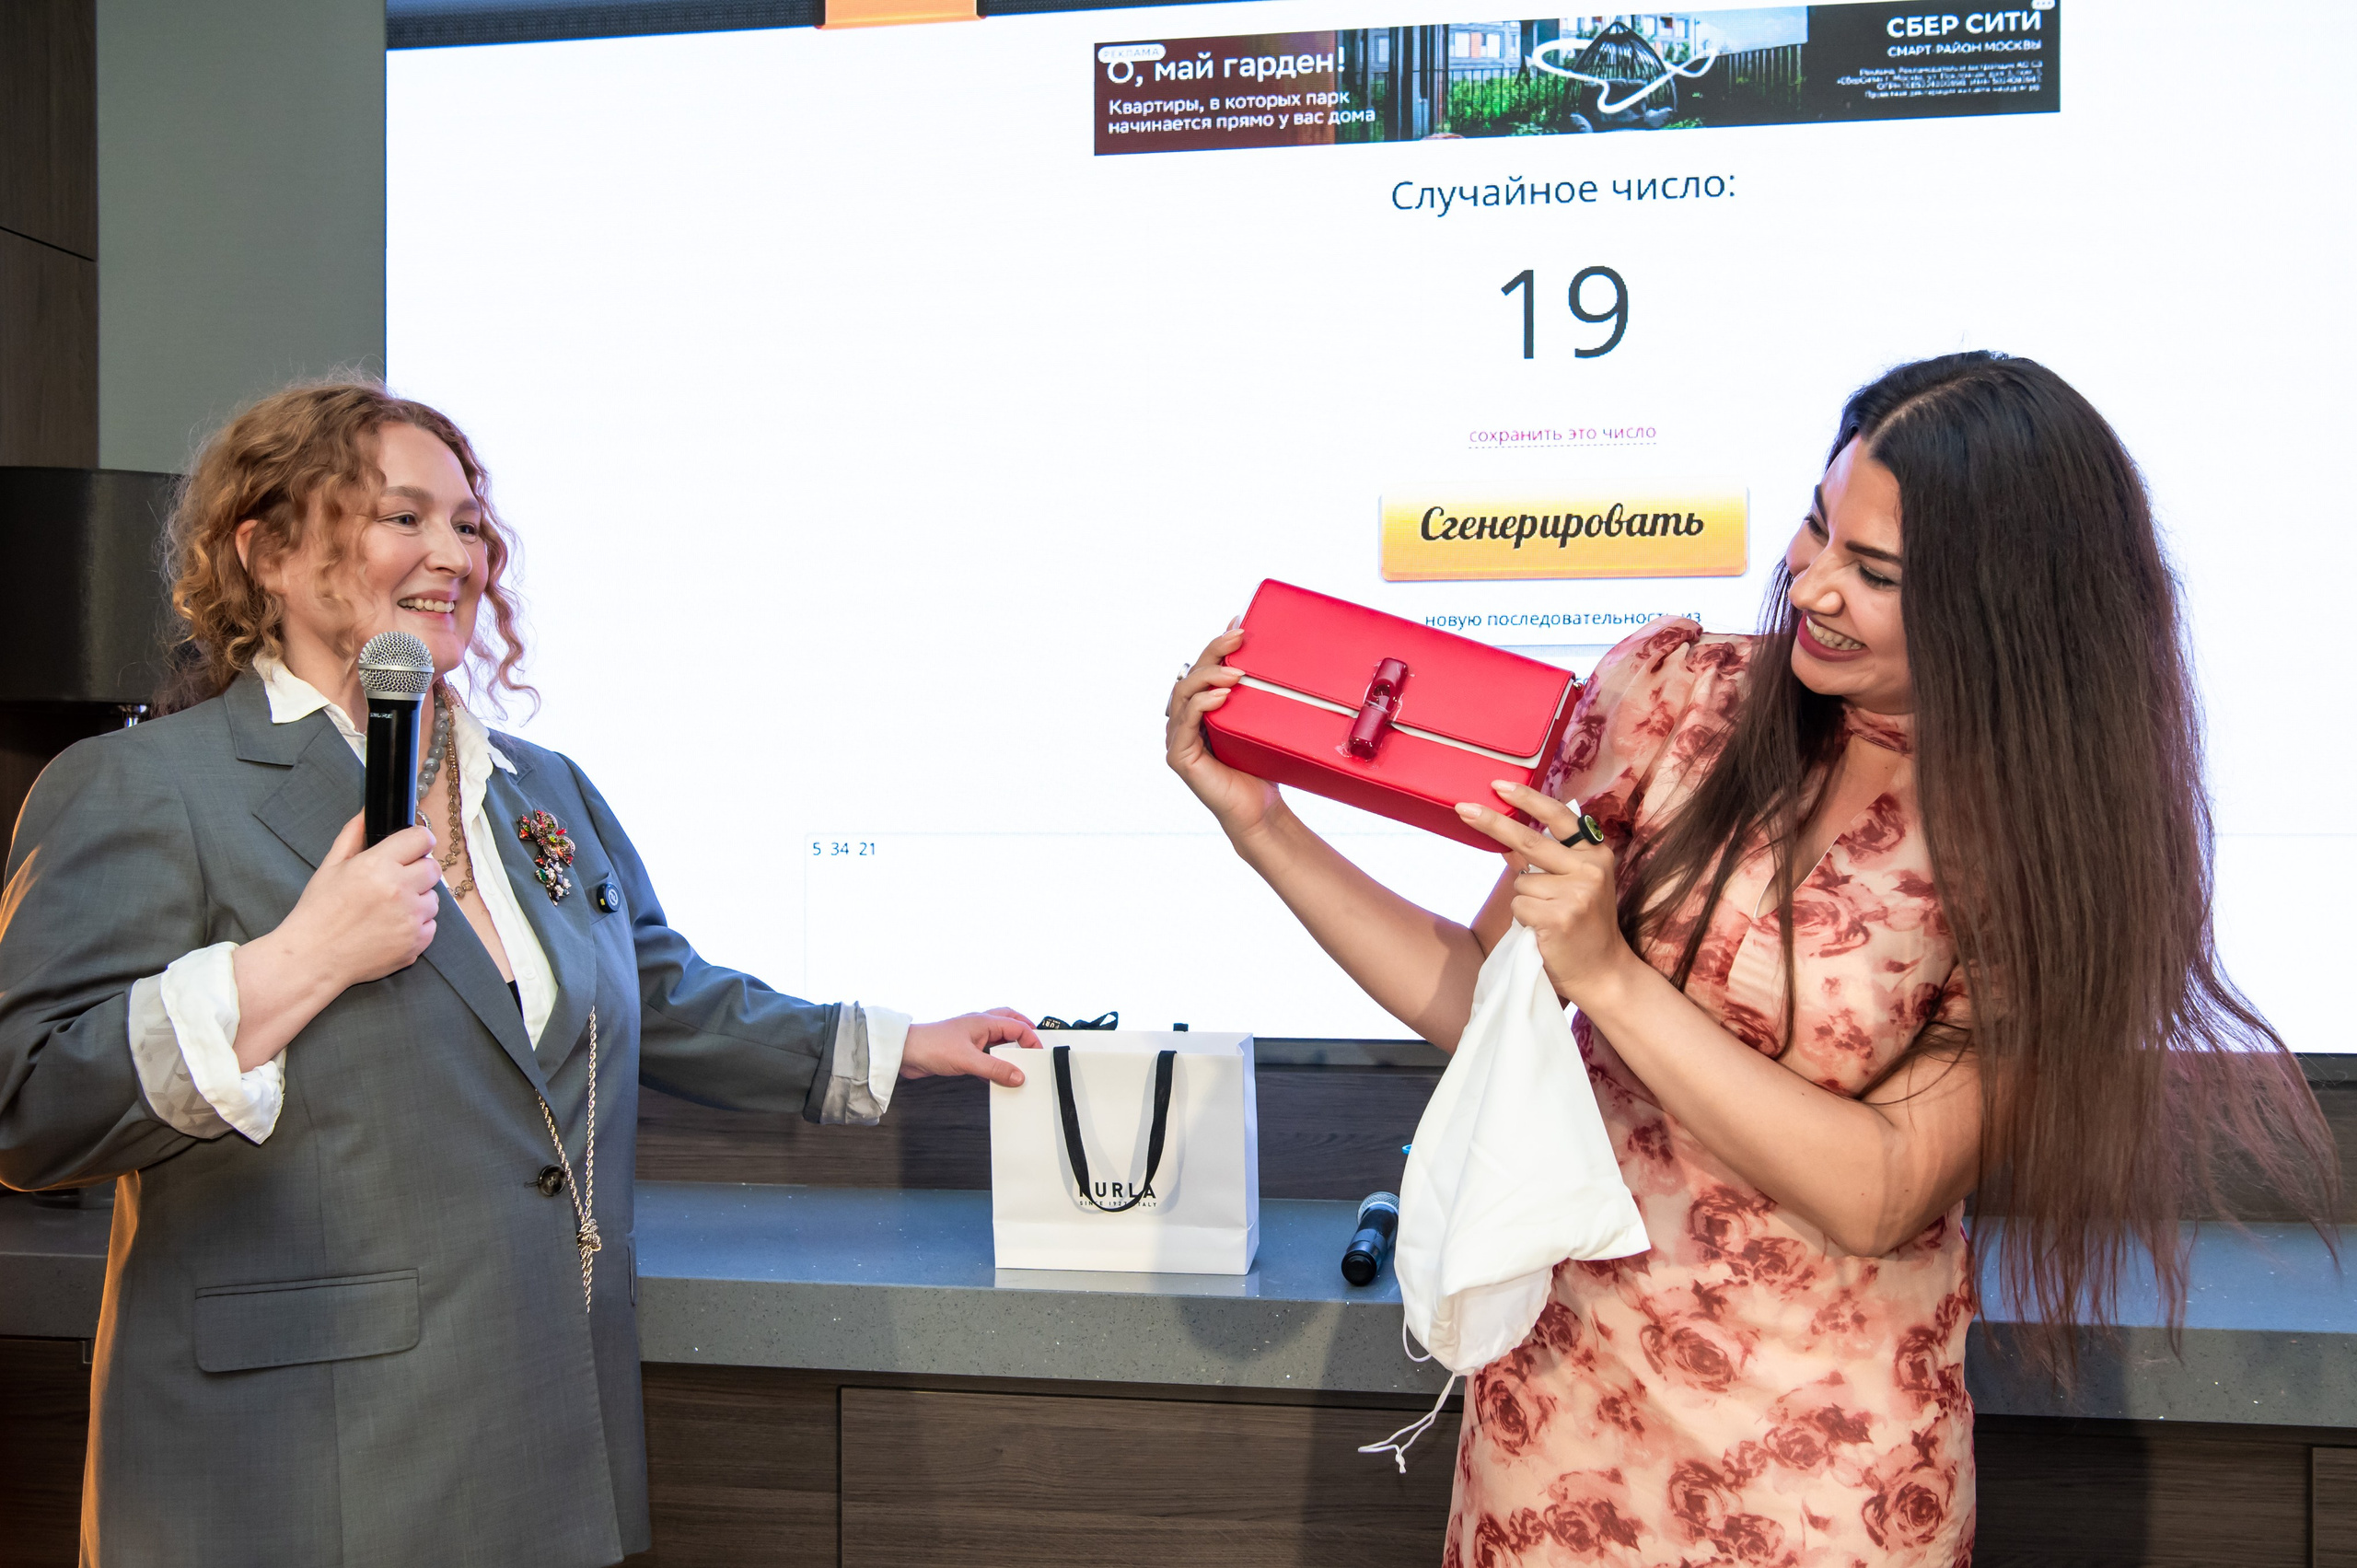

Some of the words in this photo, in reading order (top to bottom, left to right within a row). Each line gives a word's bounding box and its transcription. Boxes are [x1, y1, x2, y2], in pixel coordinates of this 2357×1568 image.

[1887, 14, 1960, 39] СБЕР
[1965, 10, 2042, 34] СИТИ
[1104, 48, 1160, 59] РЕКЛАМА
[1887, 43, 1933, 57] СМАРТ
[1936, 41, 1982, 54] РАЙОН
[1984, 39, 2042, 52] МОСКВЫ
[1107, 59, 1144, 87] О,
[1154, 51, 1214, 82] май
[1223, 46, 1346, 83] гарден!
[1109, 99, 1205, 117] Квартиры,
[1209, 97, 1220, 110] в
[1225, 94, 1302, 111] которых
[1306, 90, 1351, 108] парк
[1108, 117, 1213, 134] начинается
[1216, 113, 1275, 132] прямо
[1278, 112, 1290, 130] у
[1293, 110, 1324, 125] вас
[1327, 109, 1376, 125] дома
[1391, 175, 1598, 218] Случайное
[1612, 174, 1736, 201] число:
[1500, 264, 1630, 359] 19
[1469, 428, 1562, 446] сохранить
[1568, 428, 1597, 440] это
[1603, 426, 1656, 440] число
[1421, 502, 1705, 550] Сгенерировать
[1425, 613, 1482, 632] новую
[1488, 611, 1668, 629] последовательнос
[812, 842, 821, 856] 5
[830, 842, 850, 856] 34
[859, 842, 876, 856] 21
[1135, 1200, 1157, 1208] TALY
